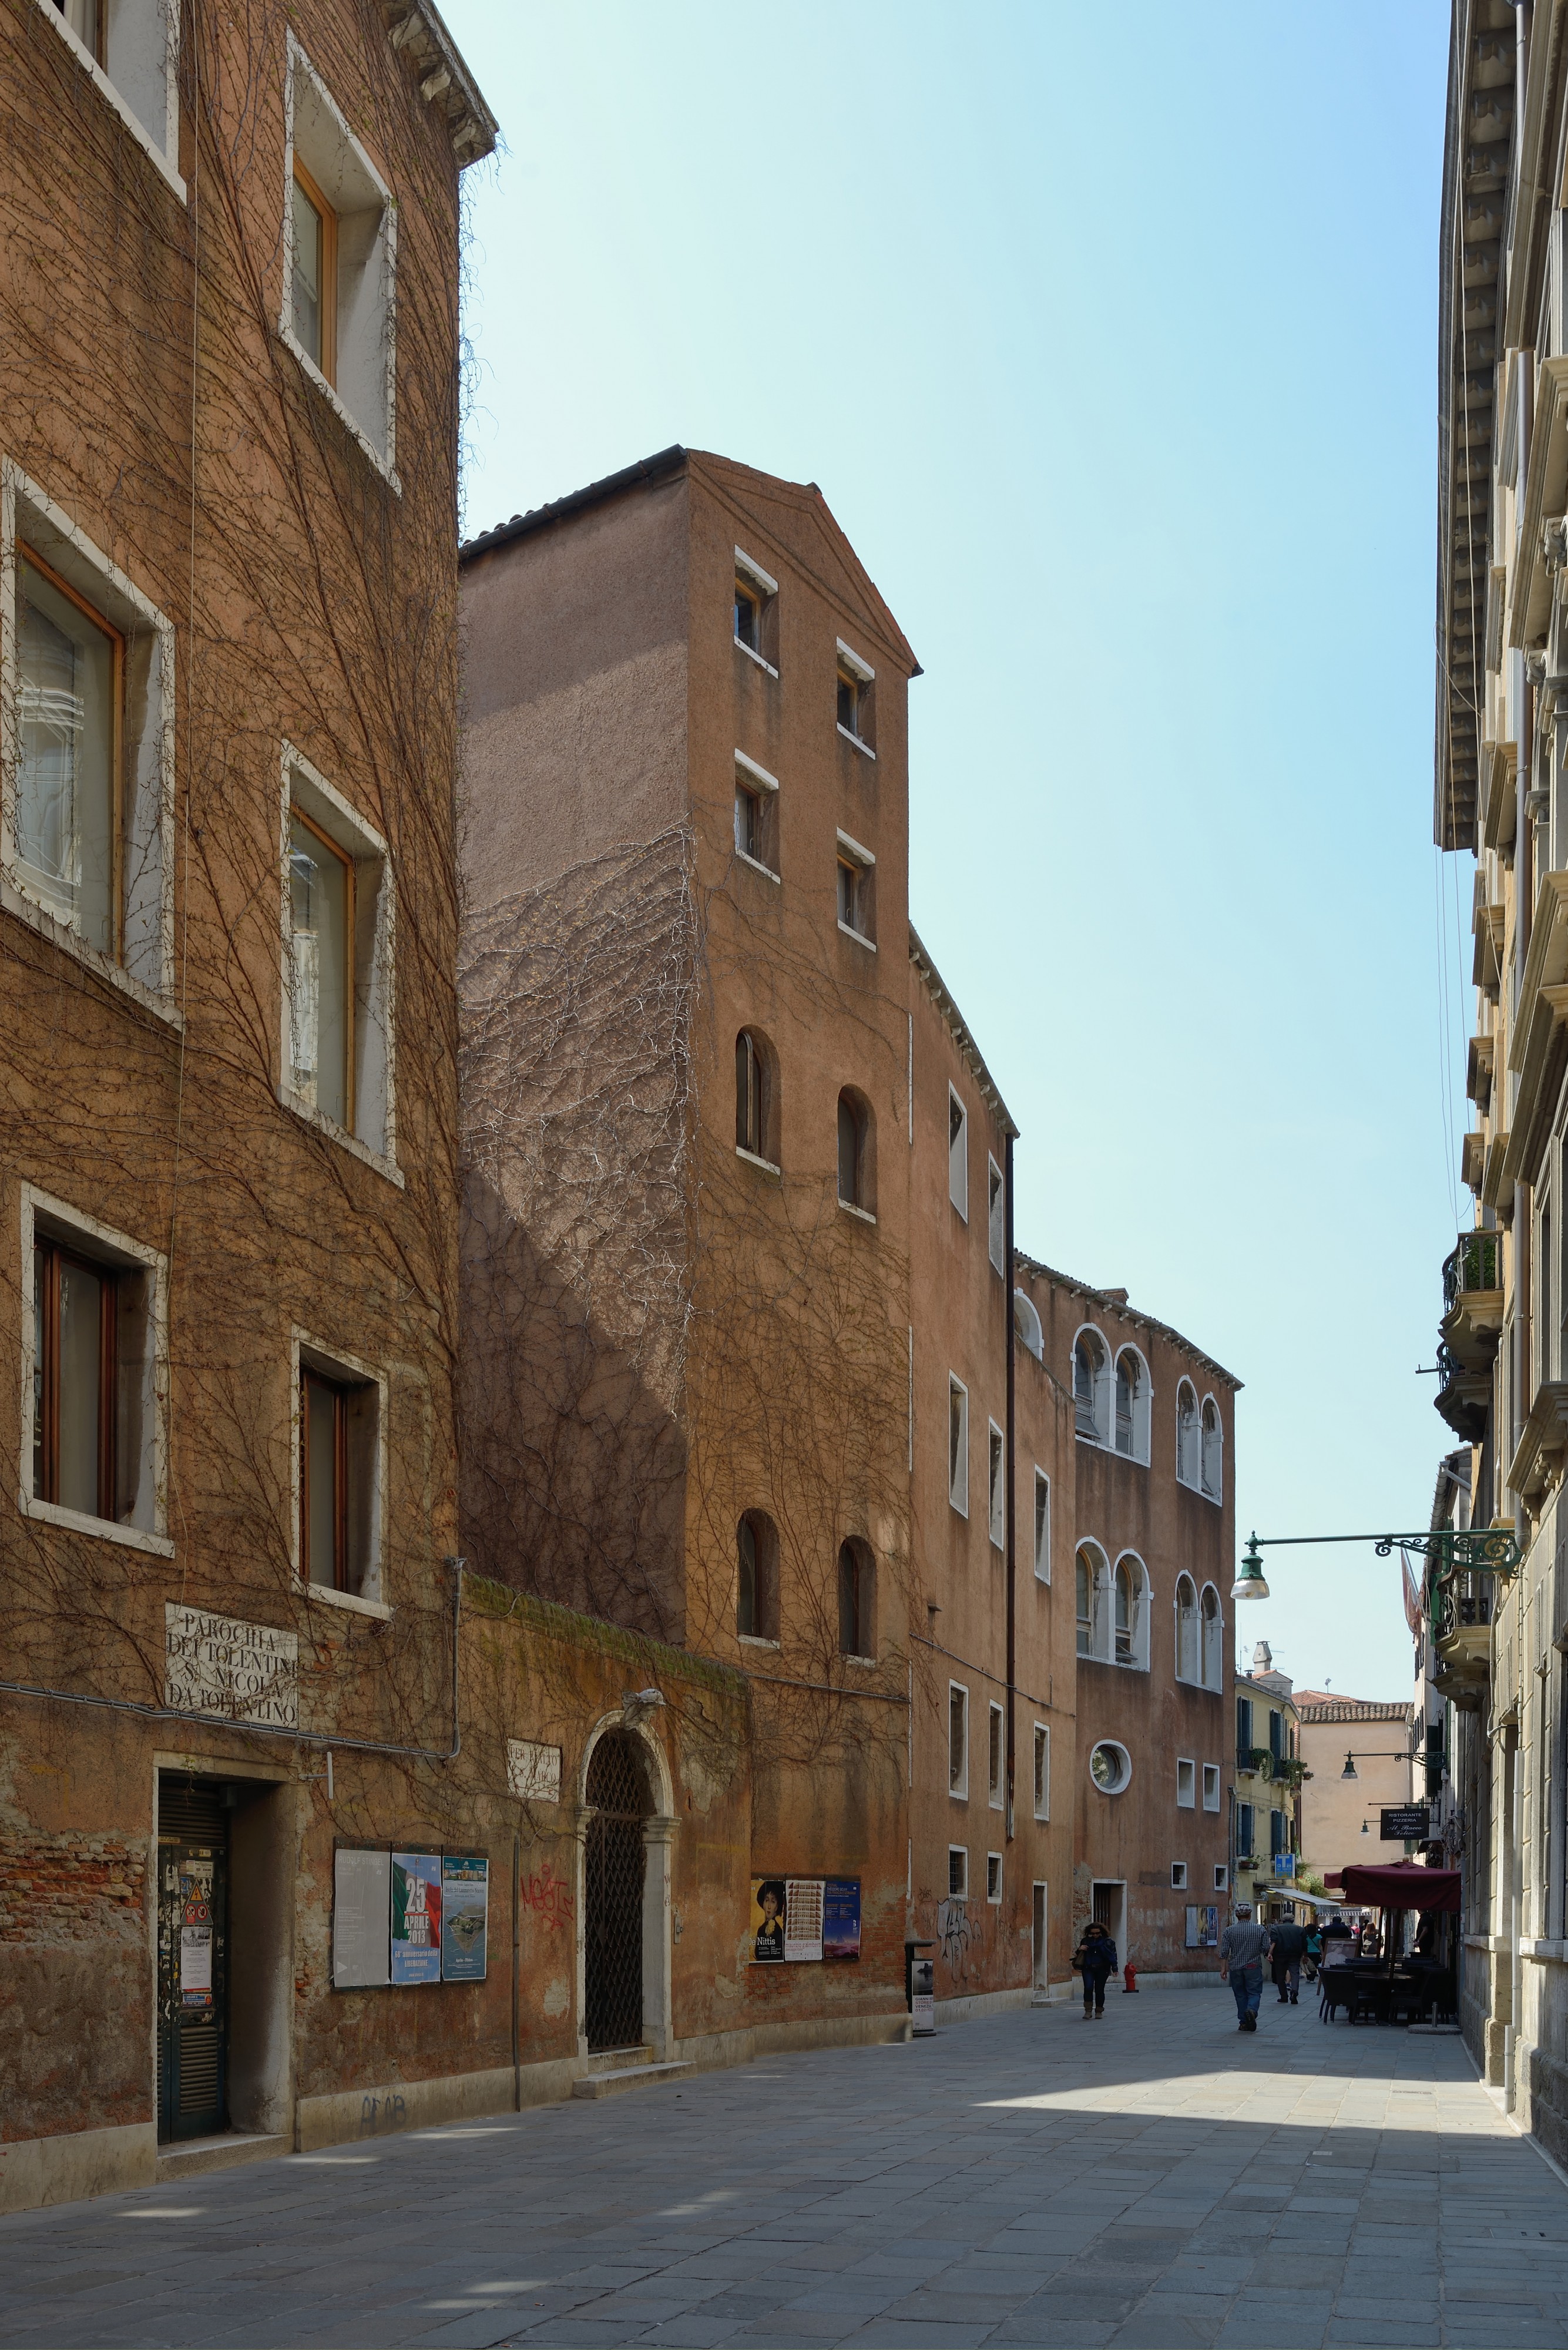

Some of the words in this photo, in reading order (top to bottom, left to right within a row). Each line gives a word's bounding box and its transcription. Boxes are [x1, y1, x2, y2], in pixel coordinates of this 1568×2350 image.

[184, 1613, 276, 1652] PAROCHIA
[168, 1633, 199, 1658] DEI
[205, 1641, 296, 1678] TOLENTINI
[215, 1667, 281, 1698] NICOLA
[169, 1683, 193, 1707] DA
[198, 1688, 296, 1723] TOLENTINO
[510, 1746, 525, 1760] PER
[529, 1750, 558, 1767] RALTO
[339, 1856, 361, 1865] RUDOLF
[362, 1857, 384, 1866] STINGEL
[405, 1878, 426, 1914] 25
[404, 1915, 429, 1930] APRILE
[407, 1931, 426, 1945] 2013
[757, 1936, 775, 1946] Nittis
[405, 1959, 428, 1968] LIBERAZIONE
